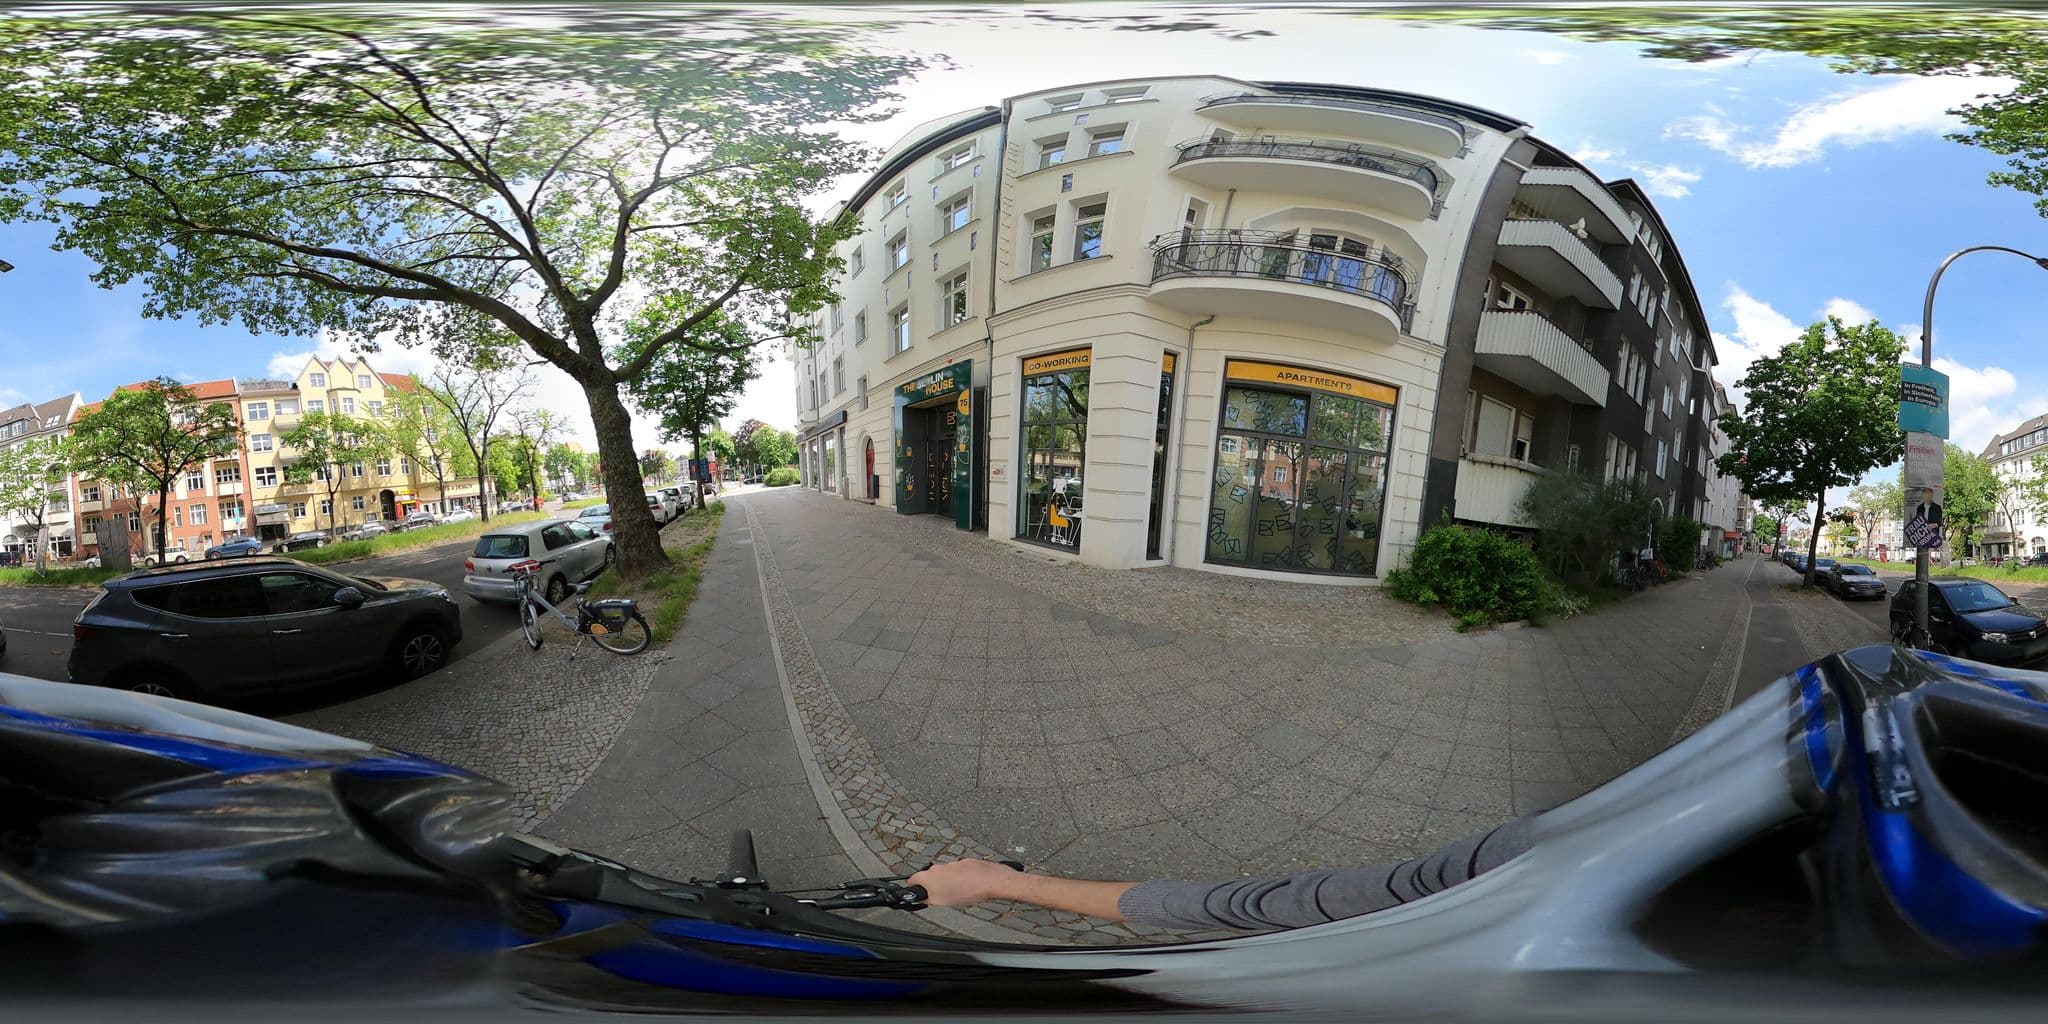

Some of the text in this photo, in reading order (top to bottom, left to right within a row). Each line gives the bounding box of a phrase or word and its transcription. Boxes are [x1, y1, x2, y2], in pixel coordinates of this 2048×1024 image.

[1028, 355, 1089, 371] CO-WORKING
[902, 382, 916, 394] THE
[925, 378, 954, 395] HOUSE
[1277, 371, 1353, 391] APARTMENTS
[960, 399, 968, 407] 75
[1905, 515, 1925, 535] TRAU
[1910, 523, 1931, 545] DICH
